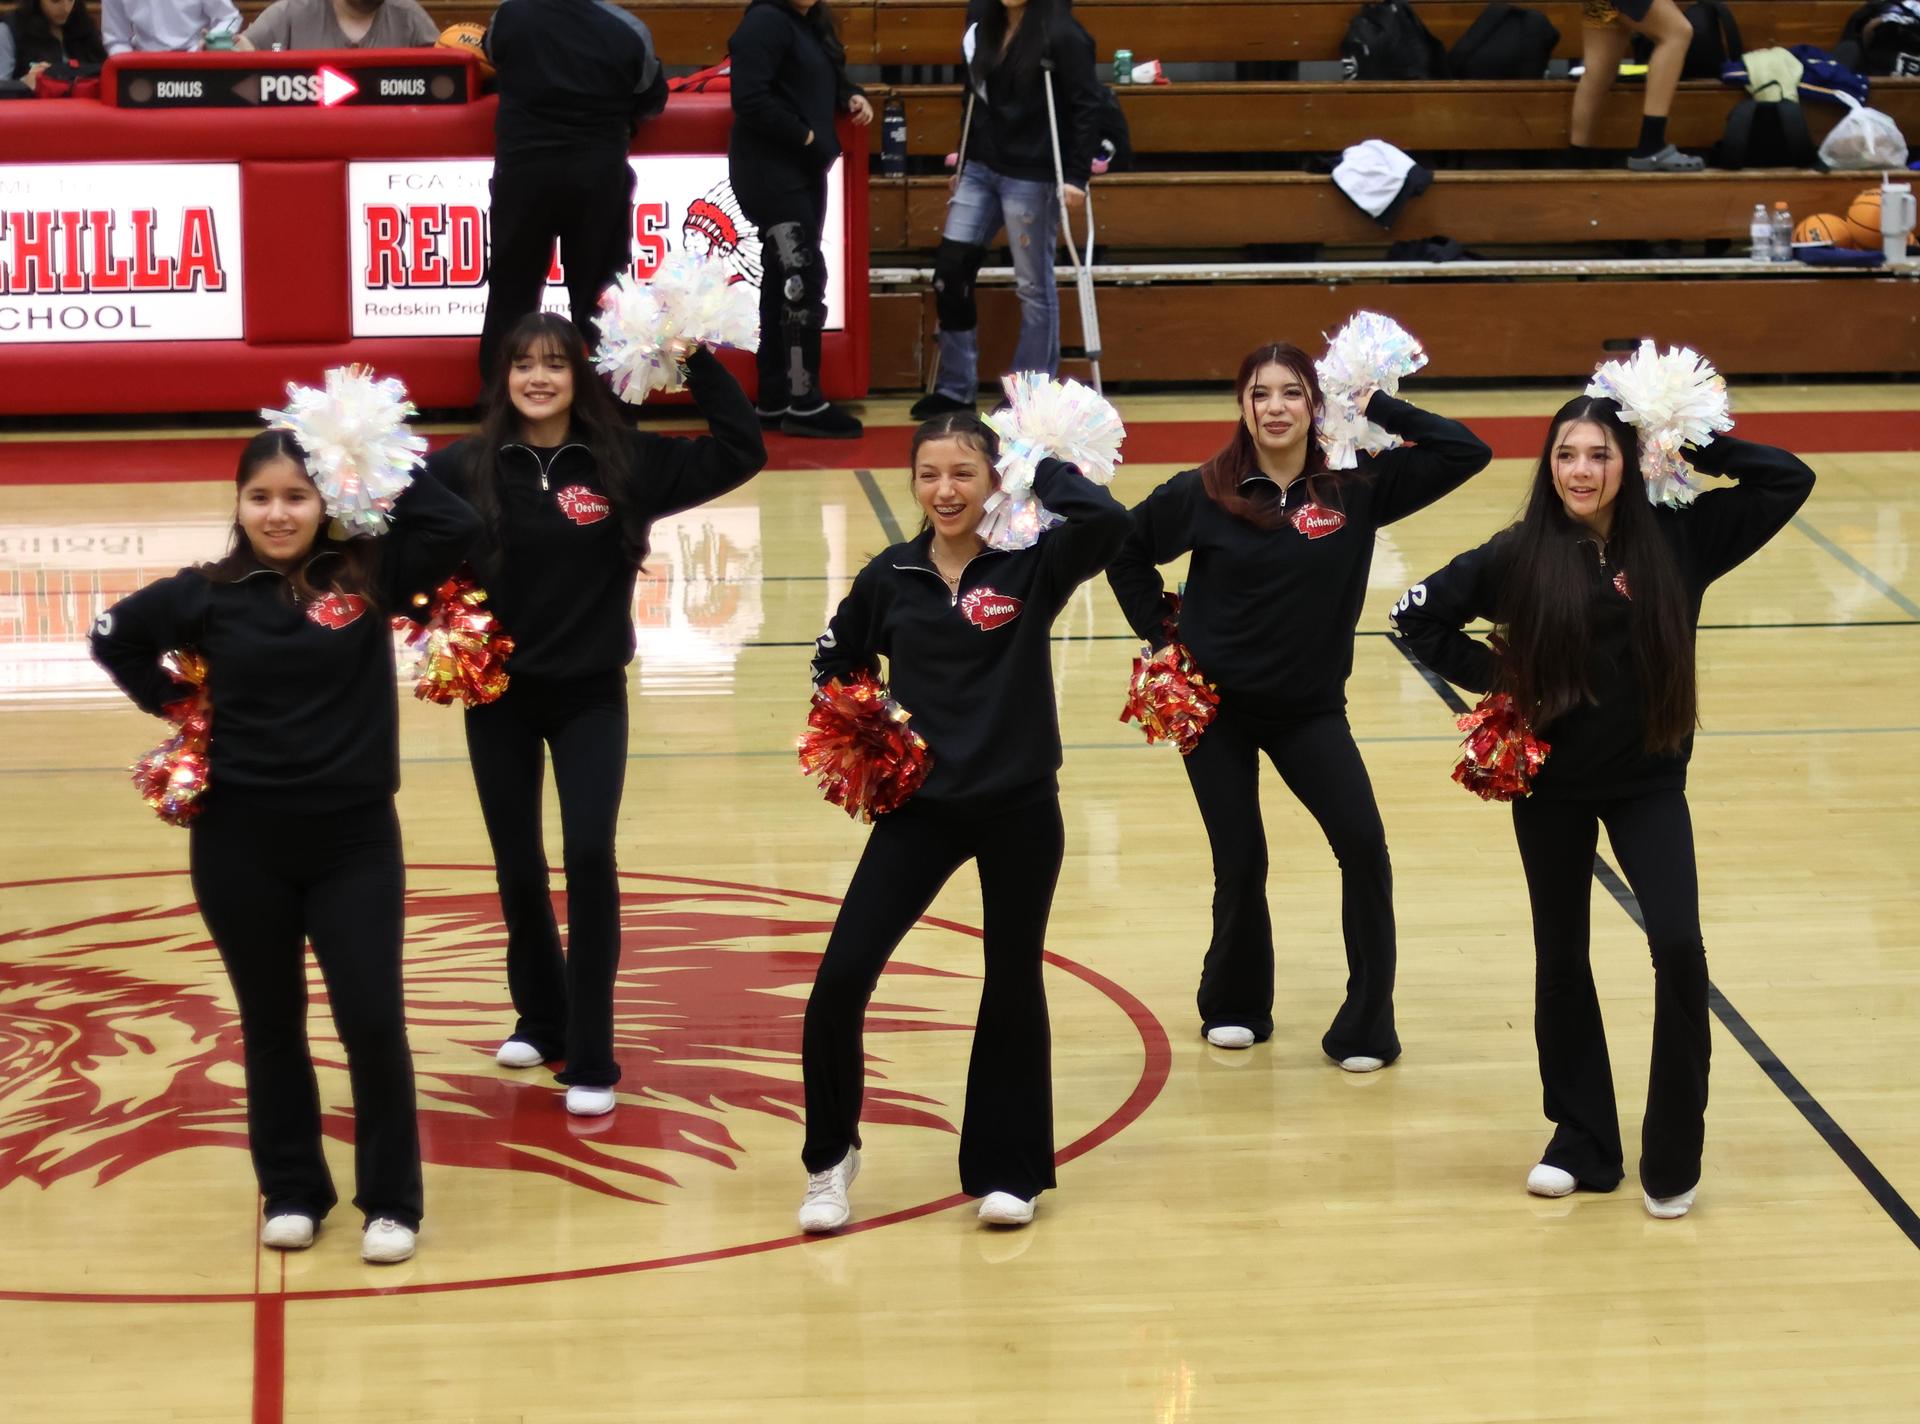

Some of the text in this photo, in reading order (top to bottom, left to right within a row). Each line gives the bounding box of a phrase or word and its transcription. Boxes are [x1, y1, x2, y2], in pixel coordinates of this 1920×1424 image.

[157, 81, 203, 98] BONUS
[260, 75, 322, 102] POSS
[380, 79, 425, 96] BONUS
[388, 174, 444, 190] FCA
[0, 206, 227, 295] HILLA
[365, 301, 485, 316] Redskin Prid
[983, 603, 1014, 618] Selena
